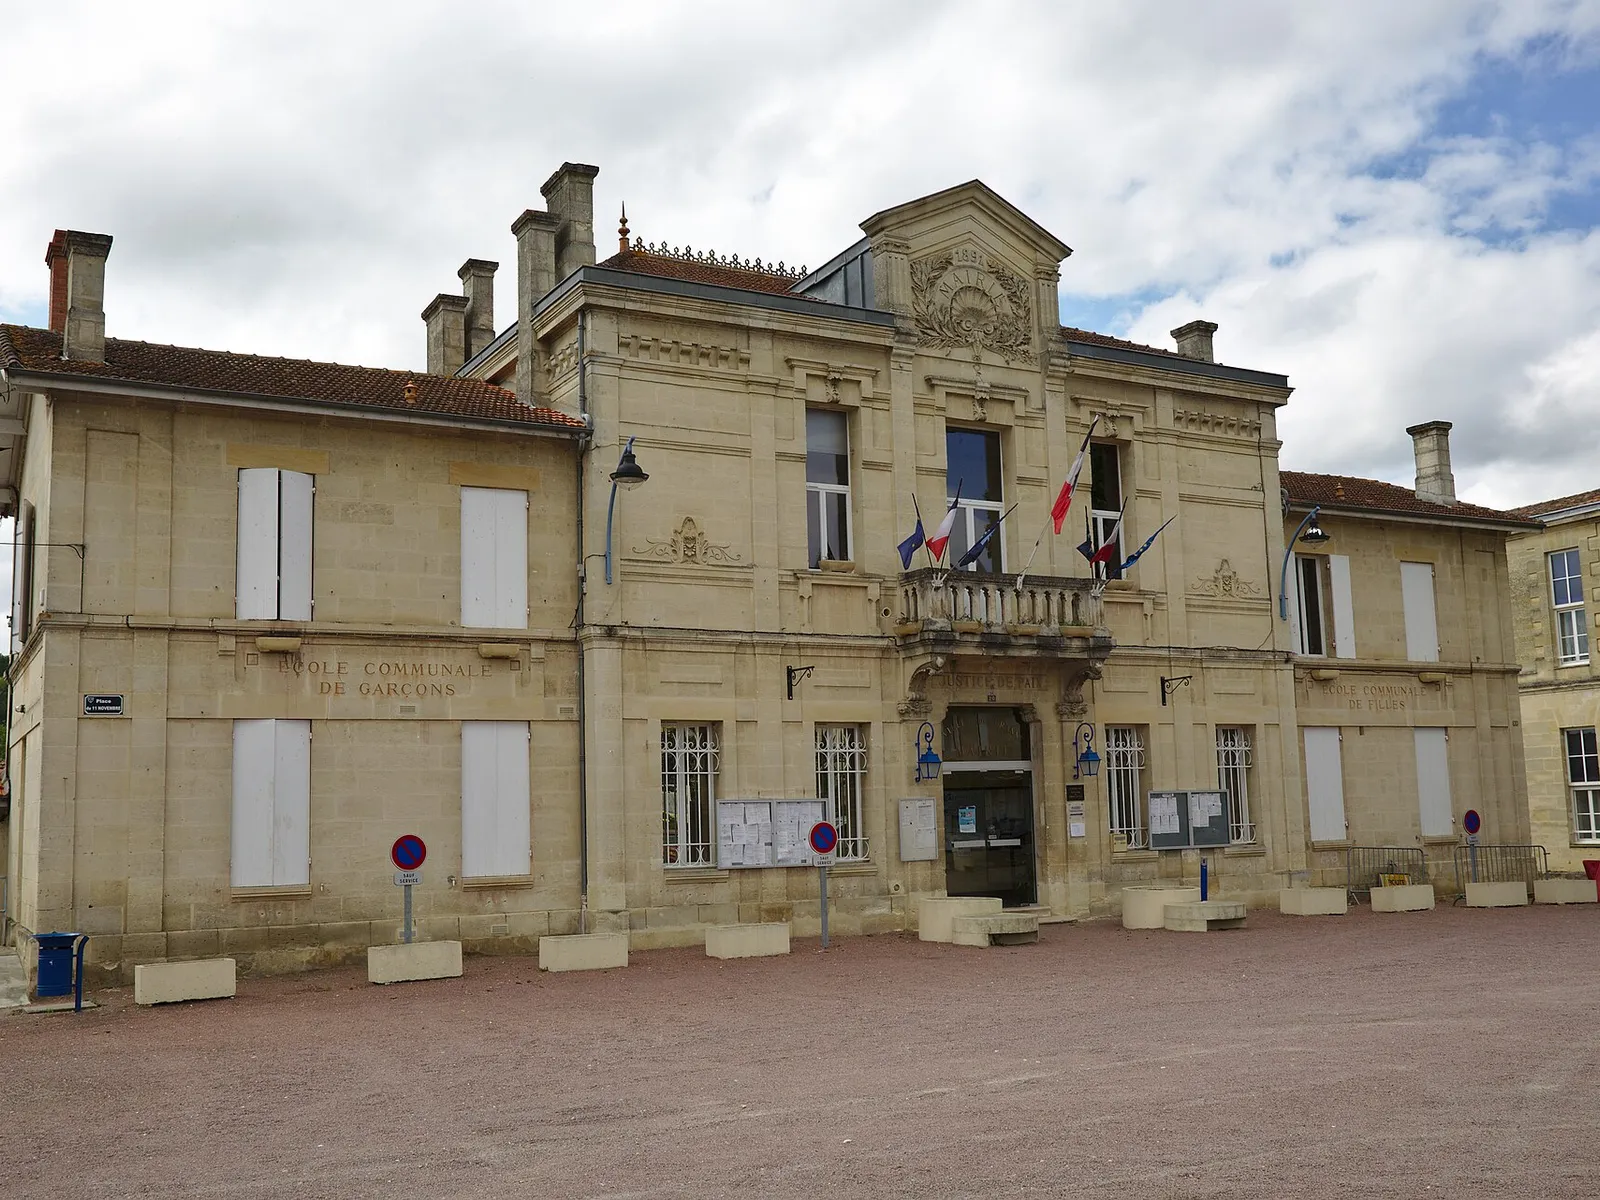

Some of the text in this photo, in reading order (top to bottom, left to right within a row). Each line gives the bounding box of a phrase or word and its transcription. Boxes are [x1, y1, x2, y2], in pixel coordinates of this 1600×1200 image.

[939, 270, 1006, 307] MAIRIE
[364, 662, 492, 677] COMMUNALE
[320, 681, 455, 698] DE GARÇONS
[1322, 684, 1427, 697] ECOLE COMMUNALE
[1349, 700, 1405, 711] DE FILLES
